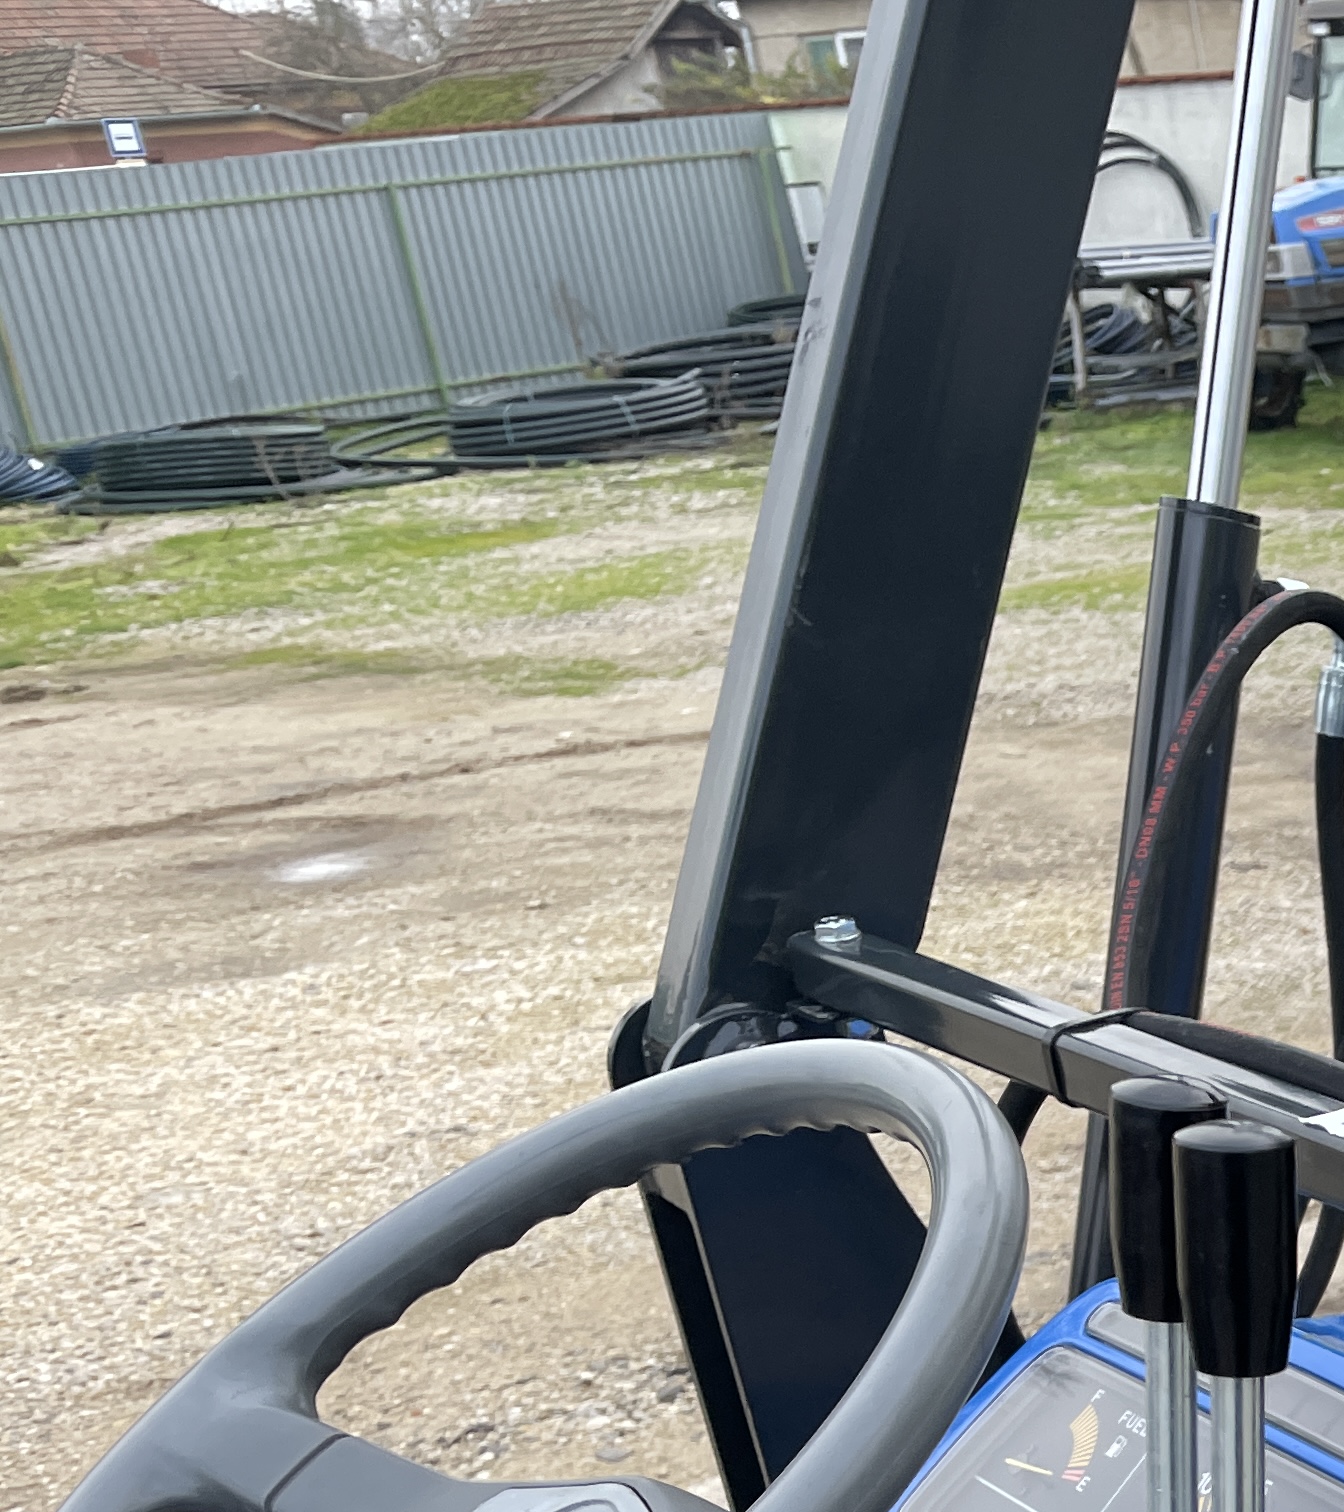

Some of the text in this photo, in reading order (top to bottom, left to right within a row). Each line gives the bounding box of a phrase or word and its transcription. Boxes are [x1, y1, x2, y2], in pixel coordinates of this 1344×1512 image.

[1149, 786, 1168, 814] MM
[1090, 1389, 1106, 1402] F
[1117, 1410, 1147, 1438] FUEL
[1075, 1476, 1091, 1493] E
